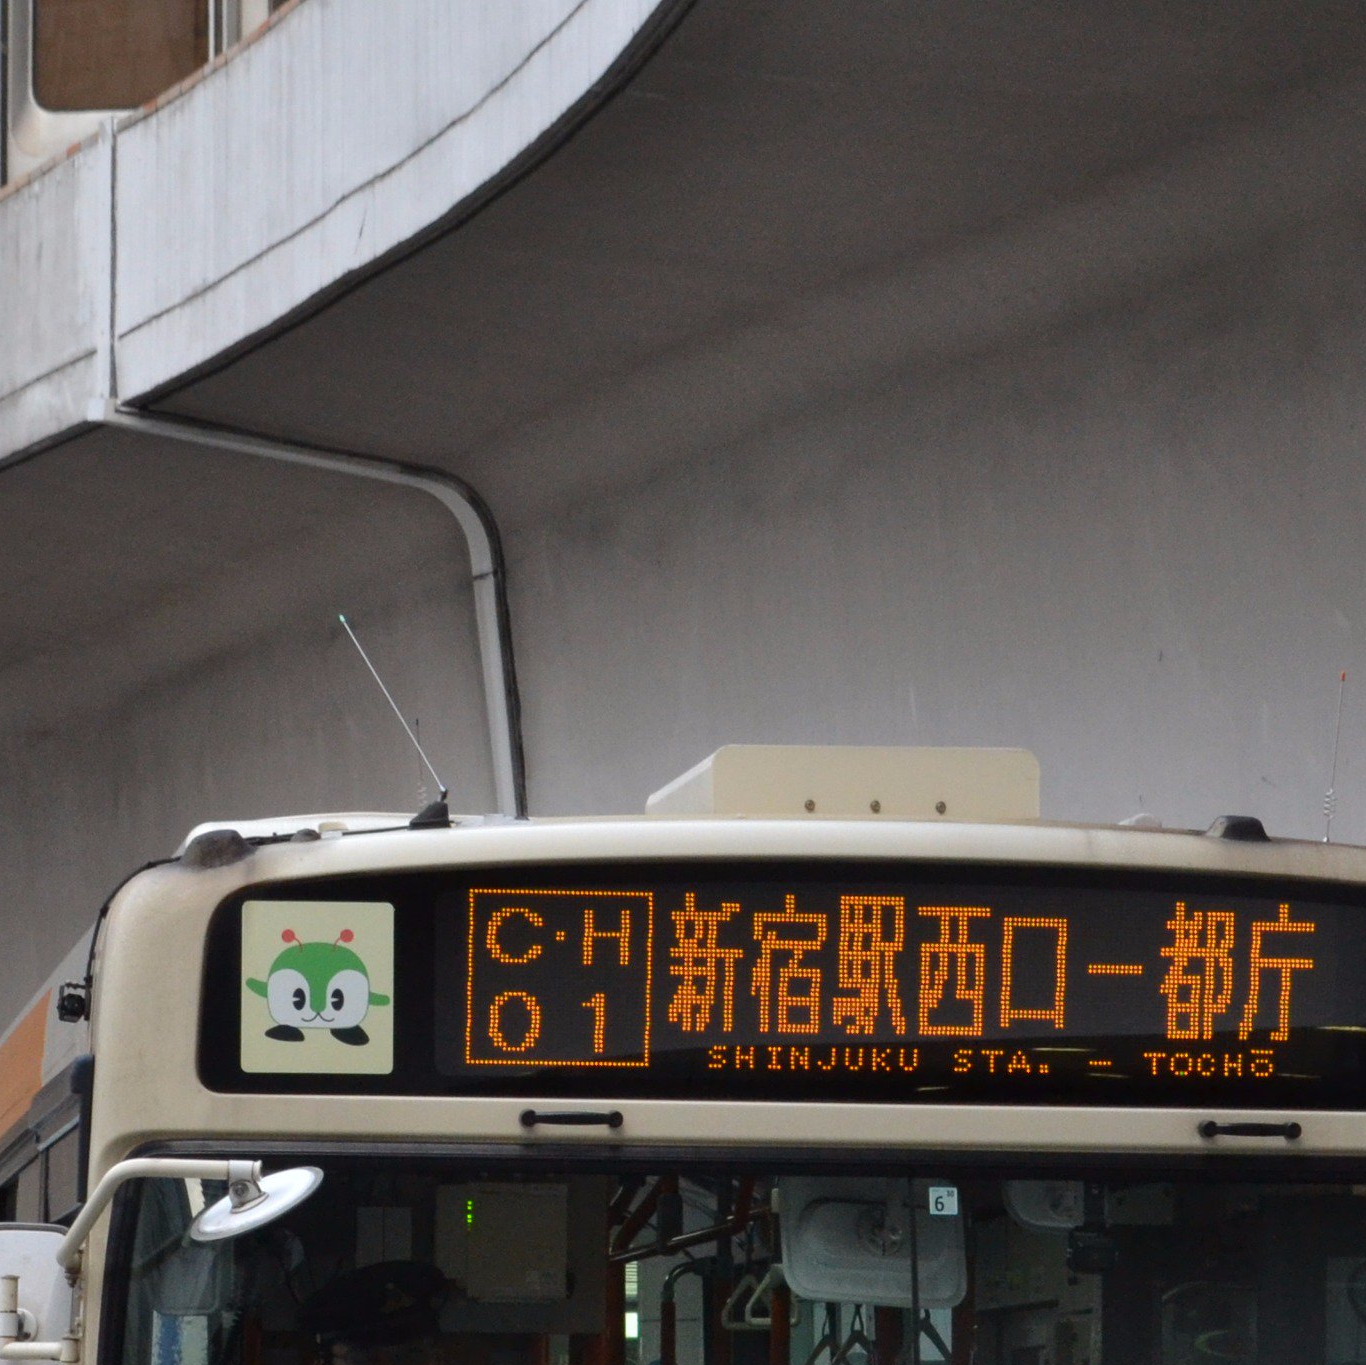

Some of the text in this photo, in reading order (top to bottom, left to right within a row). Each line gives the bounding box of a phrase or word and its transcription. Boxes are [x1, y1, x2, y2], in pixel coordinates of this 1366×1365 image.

[488, 990, 605, 1053] 01
[708, 1045, 919, 1072] SHINJUKU
[953, 1049, 1050, 1074] STA.
